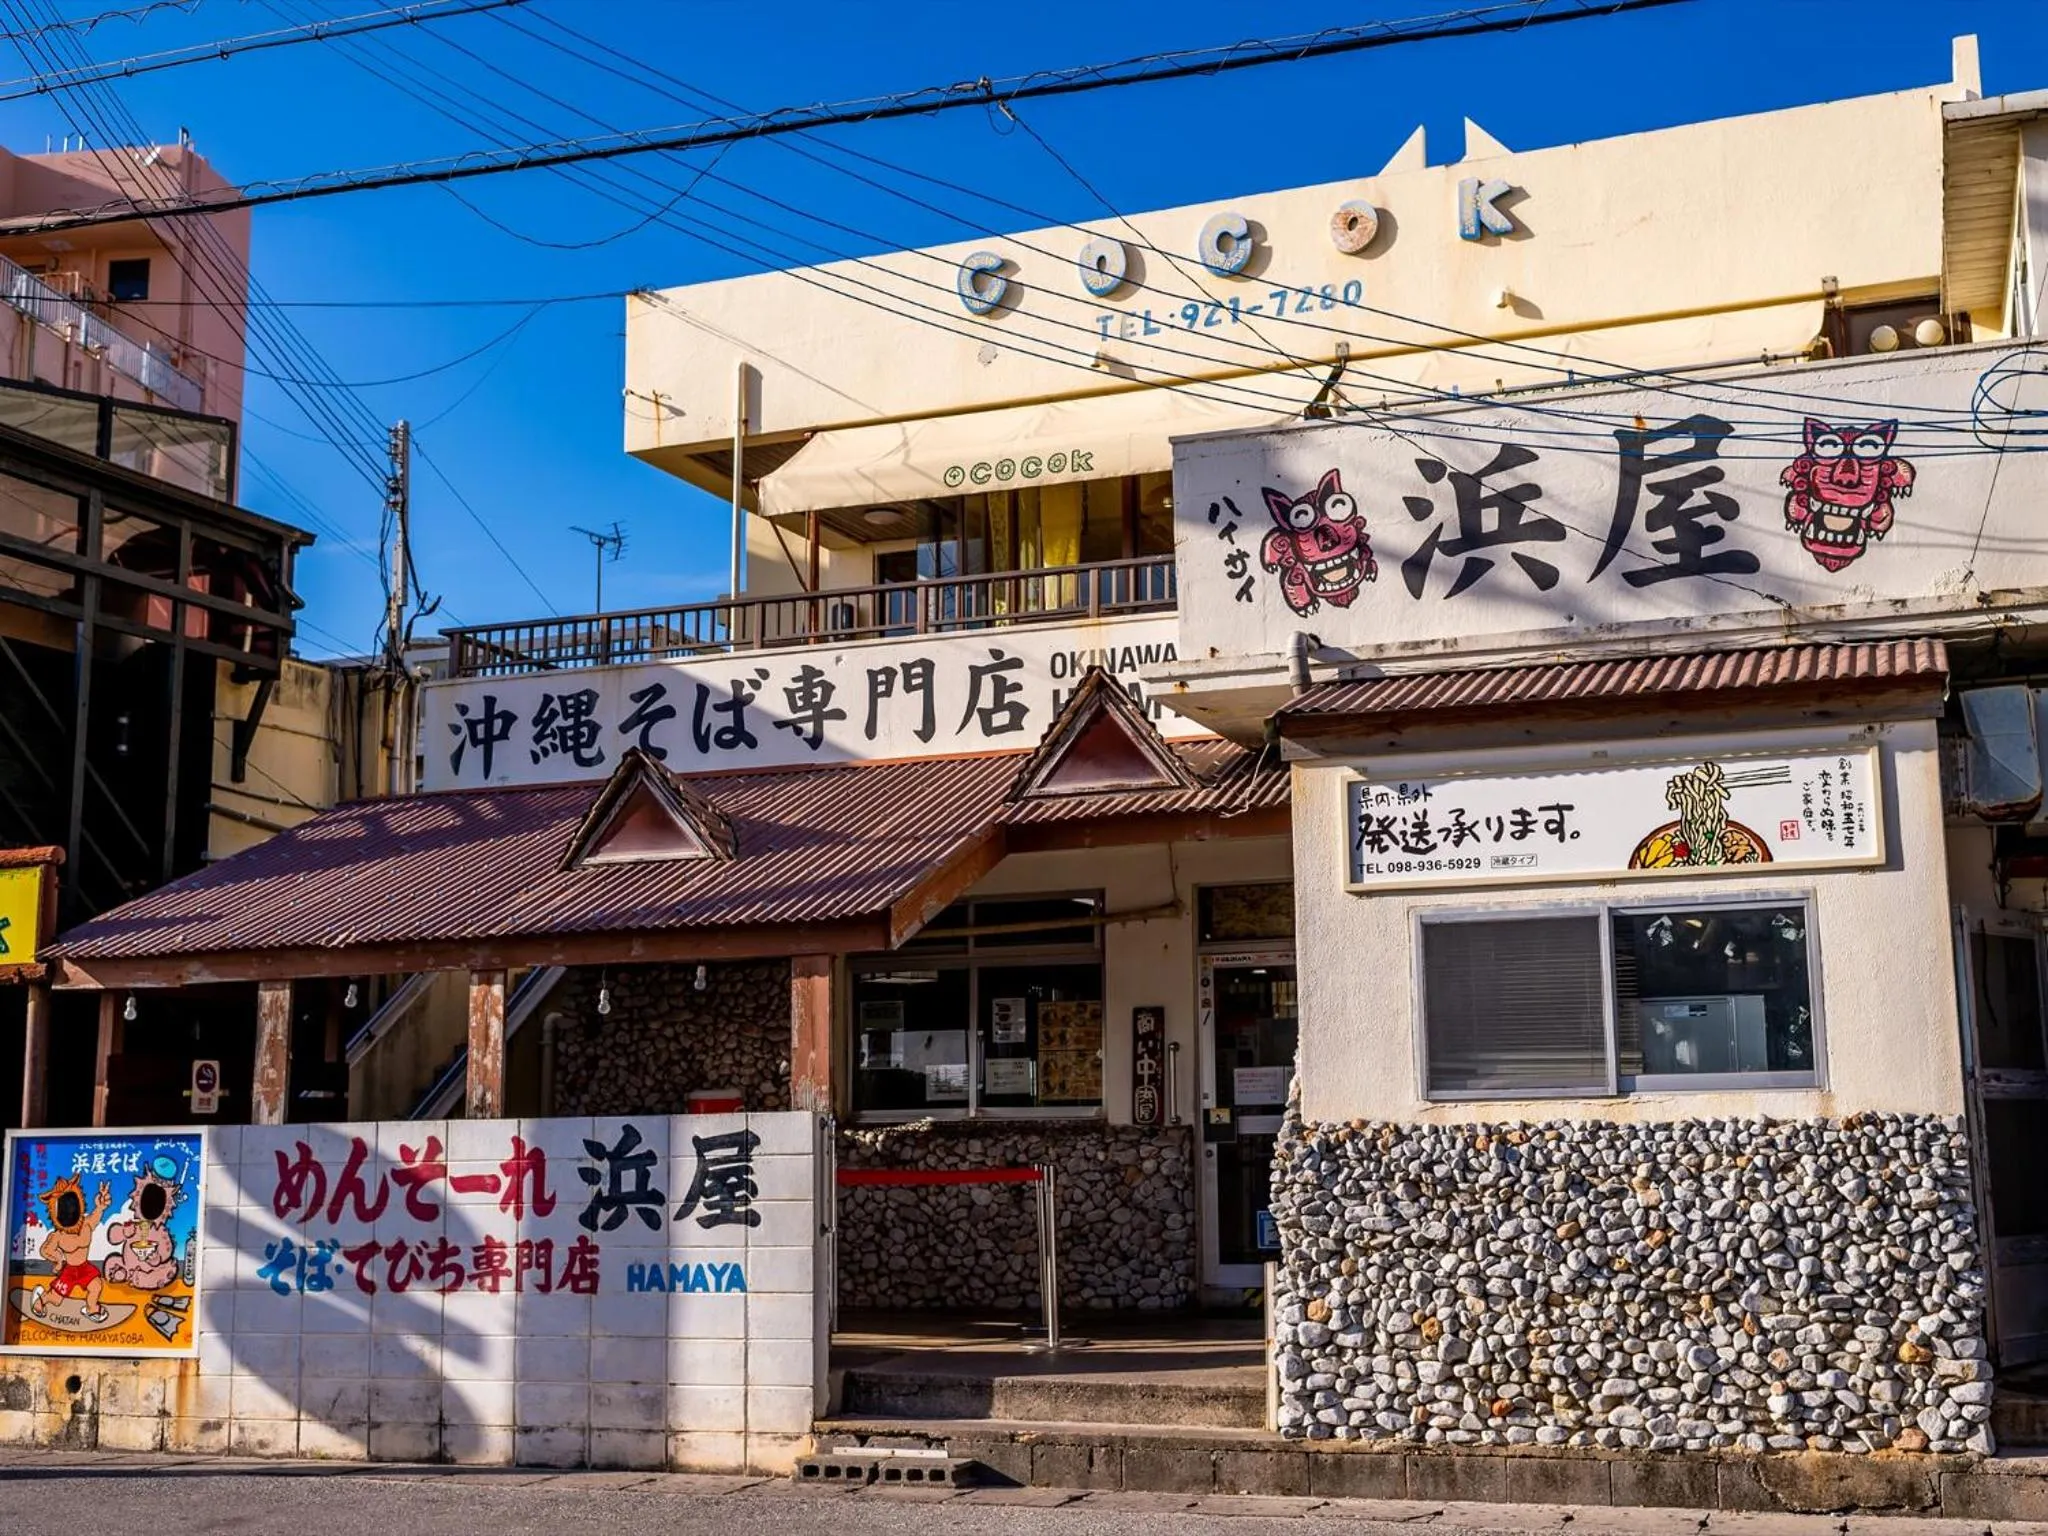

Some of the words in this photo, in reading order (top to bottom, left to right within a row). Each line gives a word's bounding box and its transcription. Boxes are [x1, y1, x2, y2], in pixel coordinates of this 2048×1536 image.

[1401, 414, 1761, 600] 浜屋
[1208, 496, 1254, 604] ハイサイ
[1050, 643, 1178, 679] OKINAWA
[448, 648, 1028, 779] 沖縄そば専門店
[1356, 803, 1581, 854] 発送承ります。
[1358, 862, 1384, 874] TEL
[1387, 857, 1481, 873] 098-936-5929
[1492, 856, 1537, 867] 冷蔵タイプ
[71, 1151, 141, 1174] 浜屋そば
[273, 1135, 557, 1226] めんそーれ
[578, 1124, 762, 1232] 浜屋
[627, 1262, 747, 1294] HAMAYA
[50, 1313, 80, 1326] CHATAN
[12, 1330, 62, 1344] WELCOME
